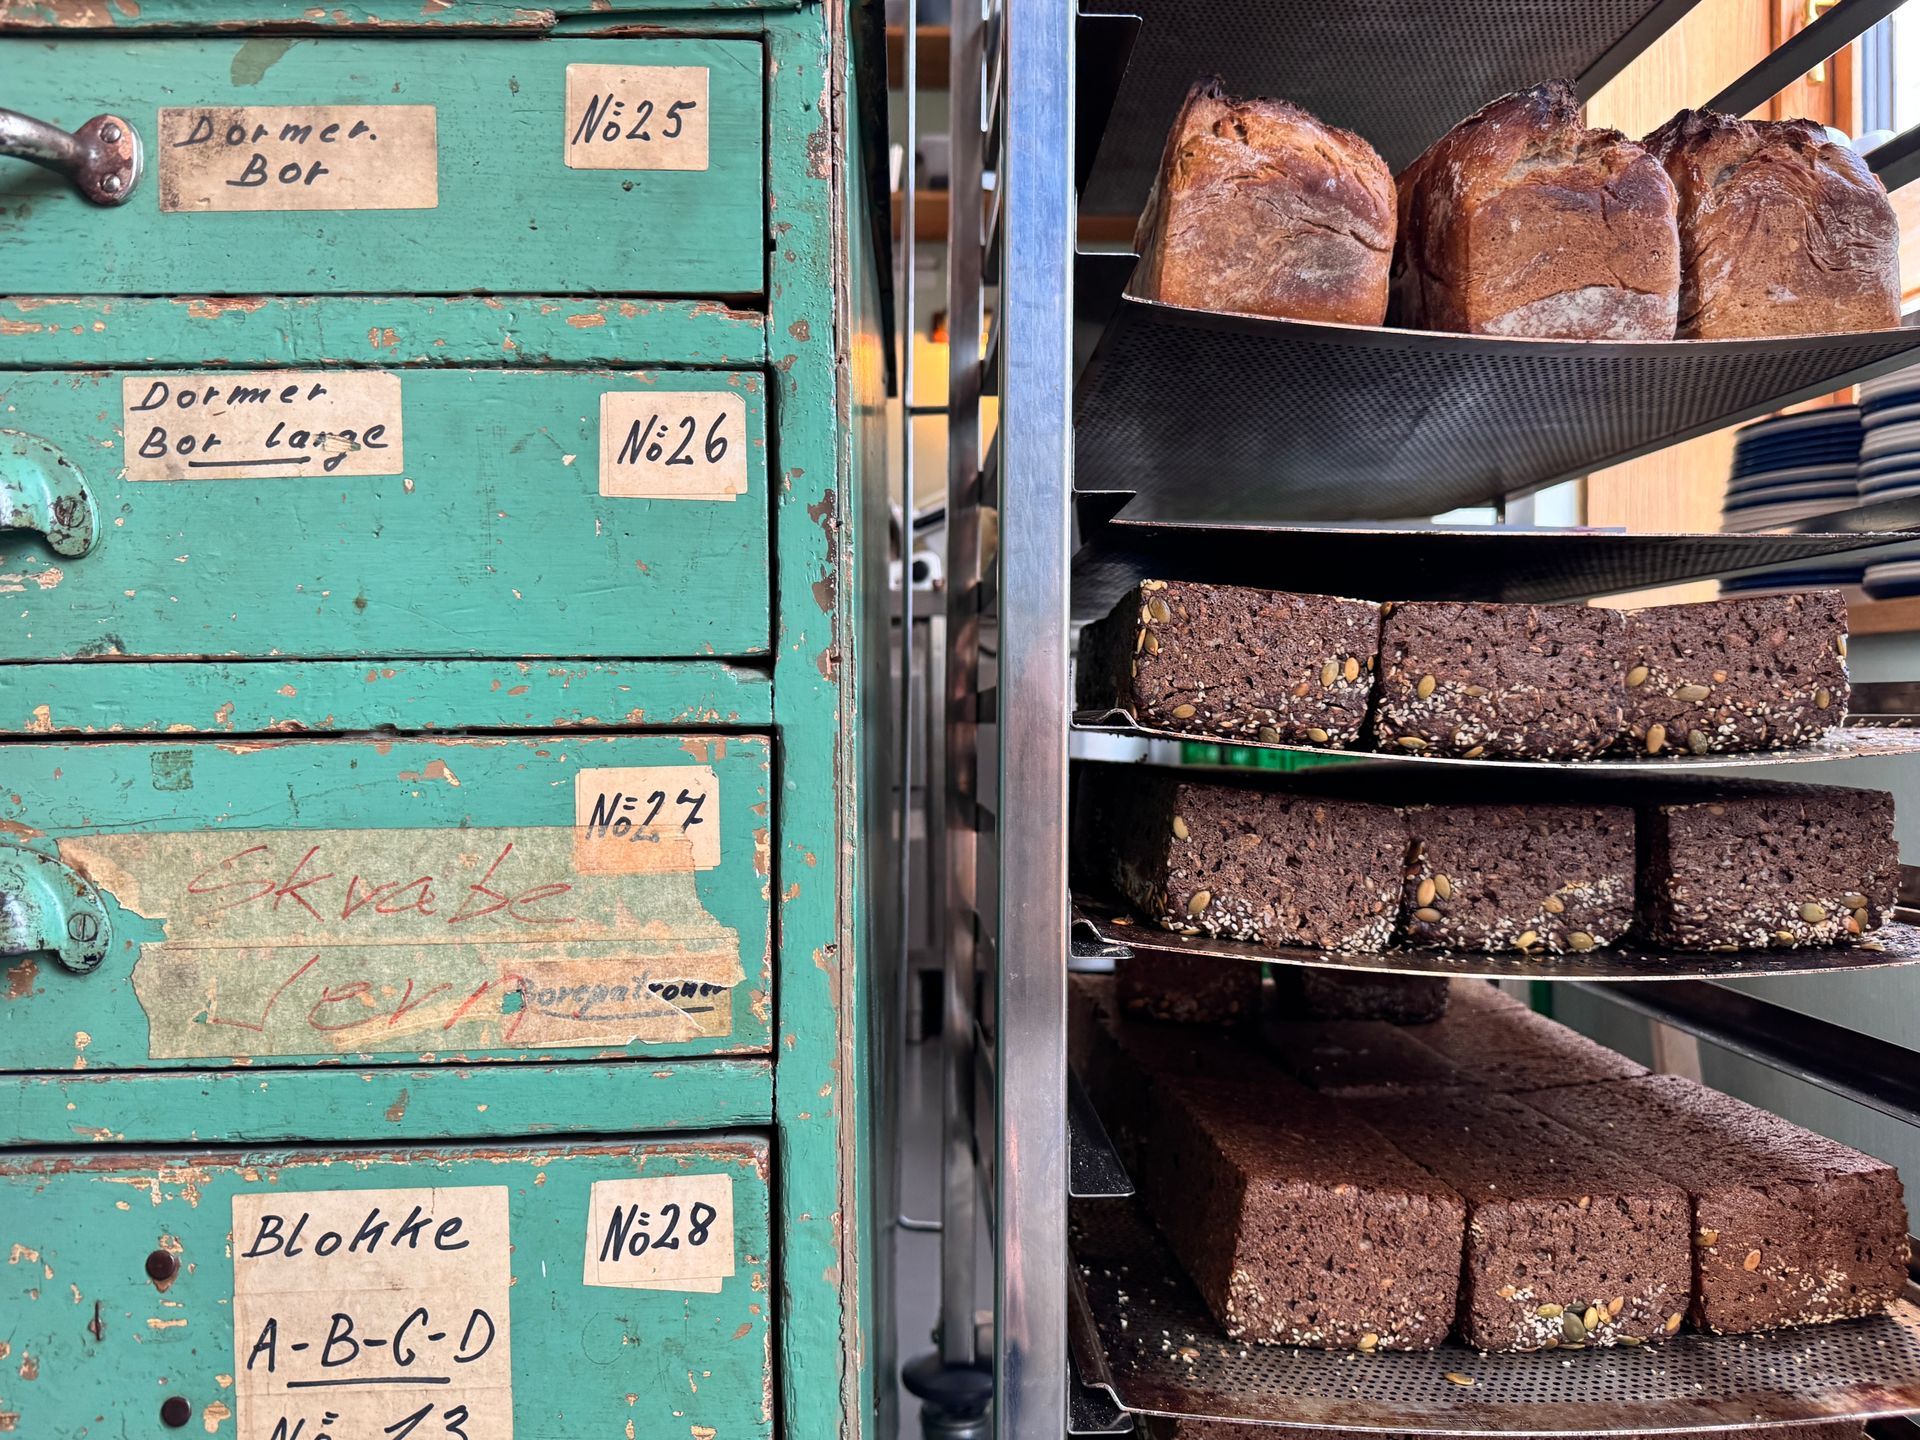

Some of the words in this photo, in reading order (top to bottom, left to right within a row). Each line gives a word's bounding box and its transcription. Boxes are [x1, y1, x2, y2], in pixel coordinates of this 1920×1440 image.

[226, 153, 329, 187] Bor
[138, 426, 221, 458] Bor
[241, 1205, 469, 1257] Blokke
